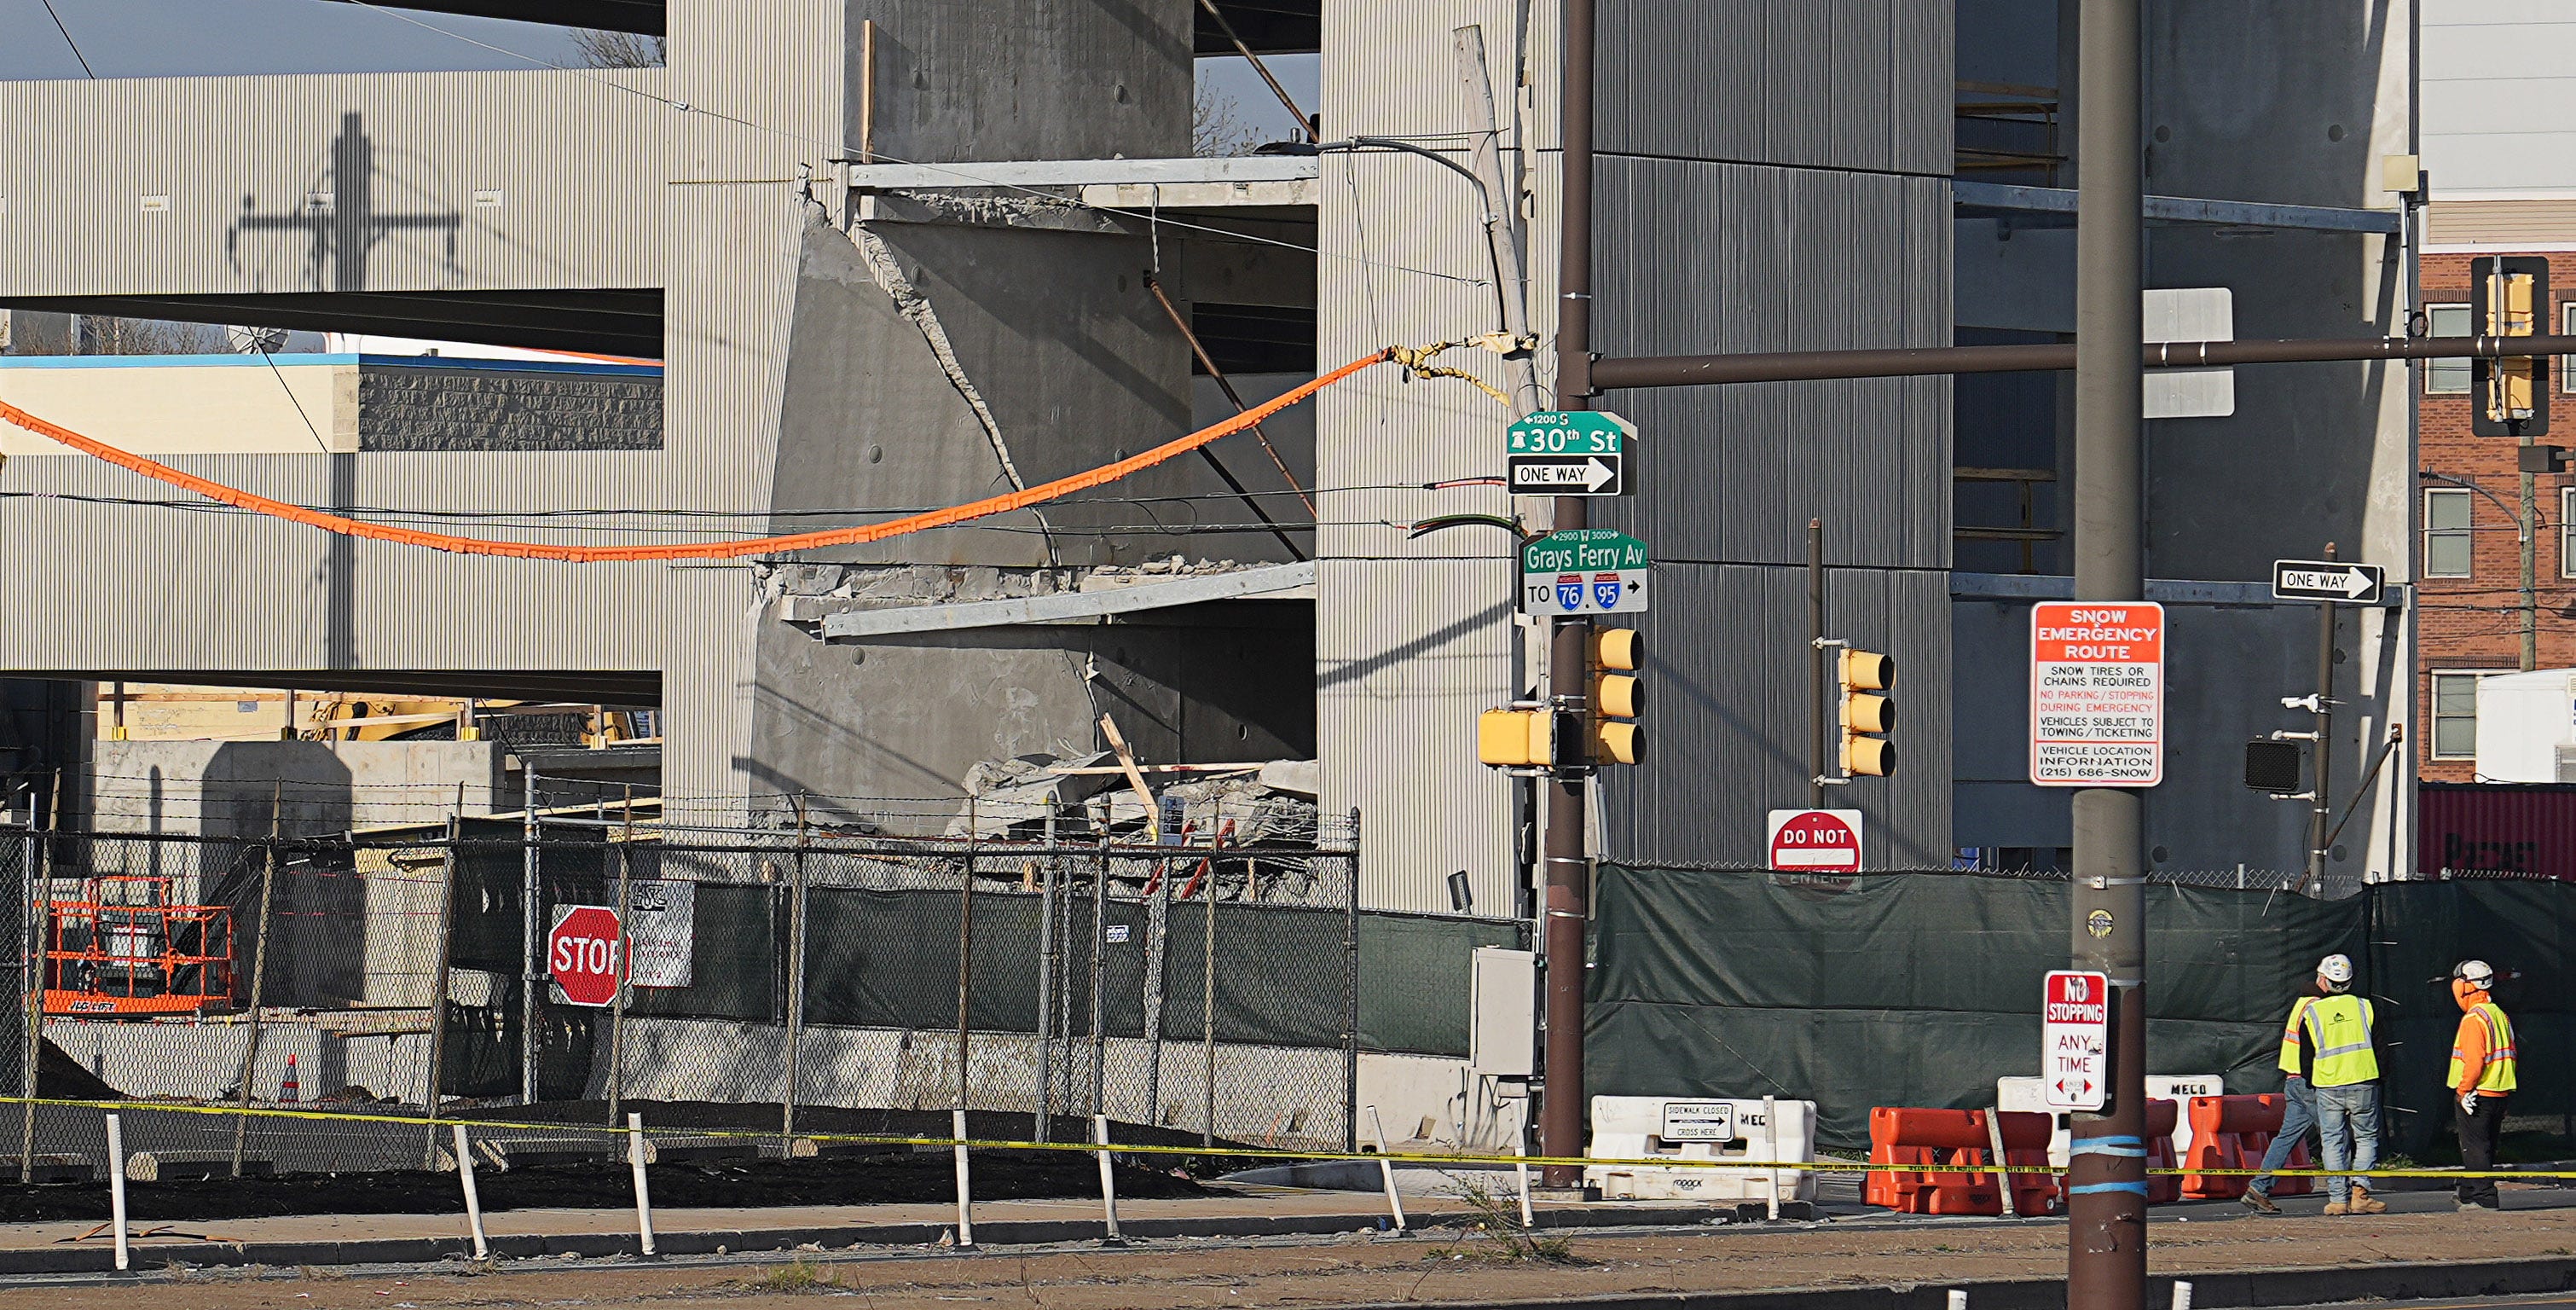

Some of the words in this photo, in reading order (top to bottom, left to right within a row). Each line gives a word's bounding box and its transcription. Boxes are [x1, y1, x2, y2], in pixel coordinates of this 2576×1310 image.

[1533, 414, 1557, 424] 1200
[1559, 413, 1569, 426] S
[1530, 428, 1581, 452] 30th
[1589, 430, 1617, 452] St
[1520, 467, 1549, 483] ONE
[1556, 467, 1587, 483] WAY
[1558, 532, 1578, 542] 2900
[1580, 530, 1589, 542] W
[1591, 530, 1612, 540] 3000
[1527, 546, 1572, 571] Grays
[1578, 544, 1620, 570] Ferry
[1624, 544, 1644, 565] Av
[2287, 572, 2314, 587] ONE
[2319, 574, 2348, 588] WAY
[1528, 585, 1550, 602] TO
[1559, 586, 1580, 605] 76
[1597, 585, 1617, 604] 95
[2069, 610, 2127, 623] SNOW
[2039, 627, 2158, 641] EMERGENCY
[2065, 645, 2131, 659] ROUTE
[2051, 666, 2085, 675] SNOW
[2091, 666, 2122, 676] TIRES
[2127, 666, 2145, 676] OR
[2044, 676, 2087, 687] CHAINS
[2093, 677, 2151, 687] REQUIRED
[2041, 690, 2054, 700] NO
[2041, 703, 2081, 713] DURING
[2087, 704, 2153, 713] EMERGENCY
[2041, 717, 2088, 727] VEHICLES
[2093, 717, 2137, 727] SUBJECT
[2141, 718, 2154, 727] TO
[2041, 746, 2089, 756] VEHICLE
[2093, 746, 2152, 756] LOCATION
[2041, 768, 2072, 777] (215)
[2077, 768, 2151, 778] 686-SNOW
[1783, 829, 1807, 844] DO
[1814, 829, 1848, 844] NOT
[2064, 977, 2088, 1002] NO
[2048, 1003, 2103, 1023] STOPPING
[2058, 1035, 2093, 1051] ANY
[2058, 1056, 2092, 1073] TIME
[2170, 1084, 2207, 1095] MECO
[1668, 1106, 1700, 1115] SIDEWALK
[1703, 1106, 1730, 1116] CLOSED
[1740, 1113, 1767, 1126] MEC
[1677, 1127, 1699, 1137] CROSS
[1700, 1127, 1717, 1137] HERE
